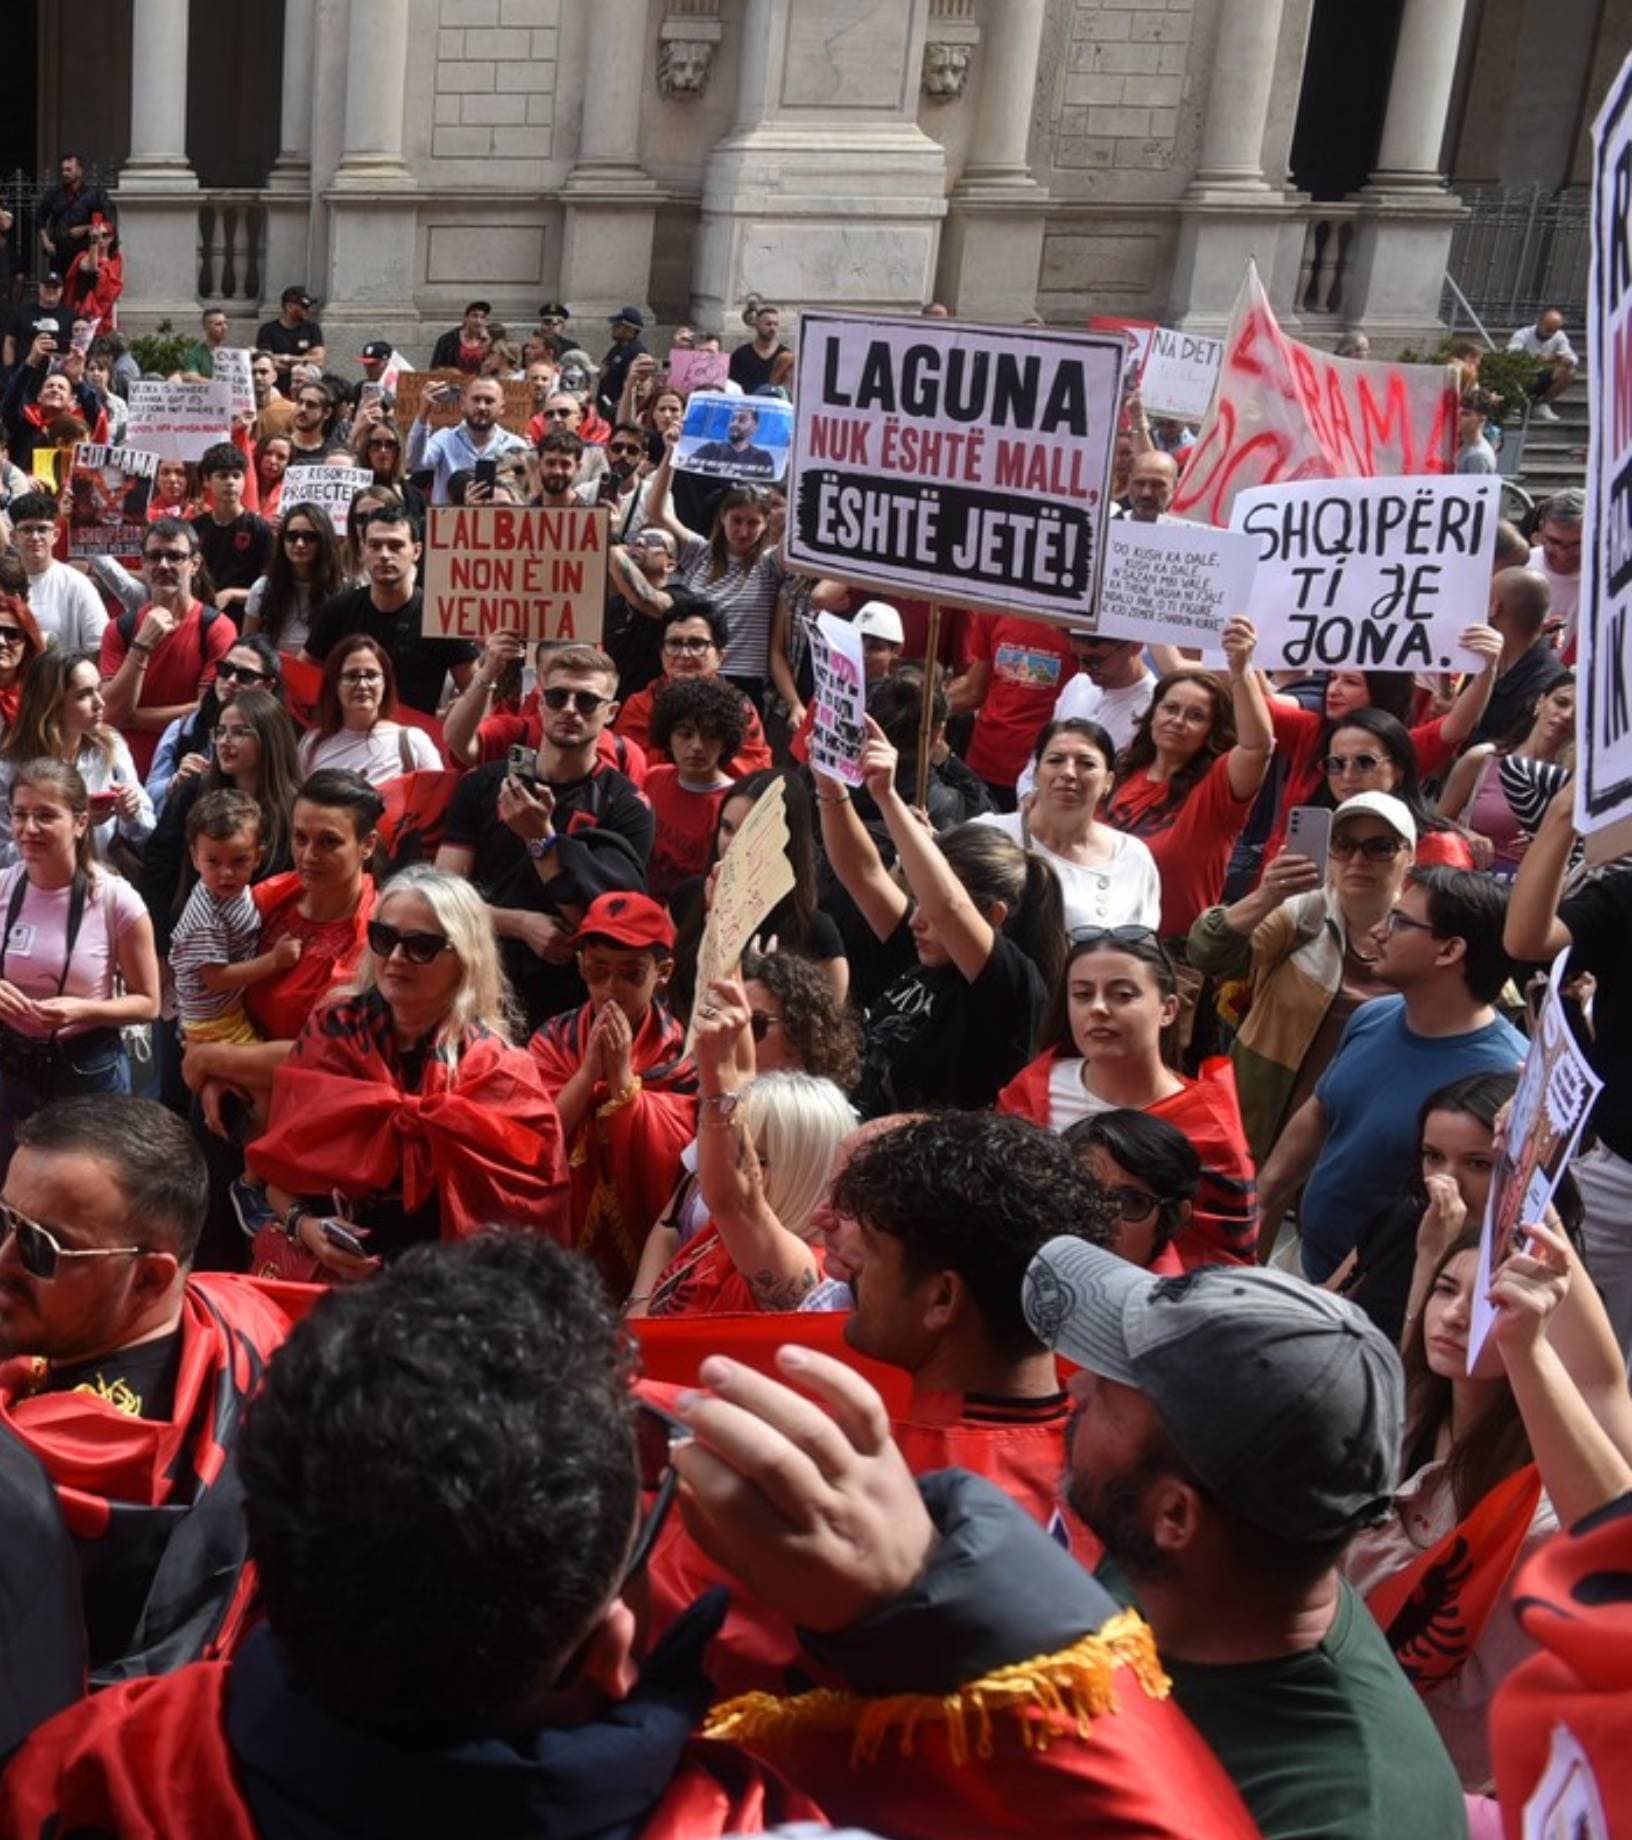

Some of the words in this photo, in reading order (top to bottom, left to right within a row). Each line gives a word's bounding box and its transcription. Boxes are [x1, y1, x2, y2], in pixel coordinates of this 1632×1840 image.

[822, 336, 1088, 437] LAGUNA
[810, 414, 871, 466] NUK
[880, 416, 985, 482] ËSHTË
[995, 440, 1099, 506] MALL,
[817, 473, 941, 564] ËSHTË
[951, 506, 1079, 588] JETË!
[451, 557, 513, 591] NON
[524, 553, 543, 592] È
[552, 560, 583, 594] IN
[1370, 563, 1442, 620] JE
[437, 596, 575, 640] VENDITA
[1282, 614, 1451, 667] JONA.
